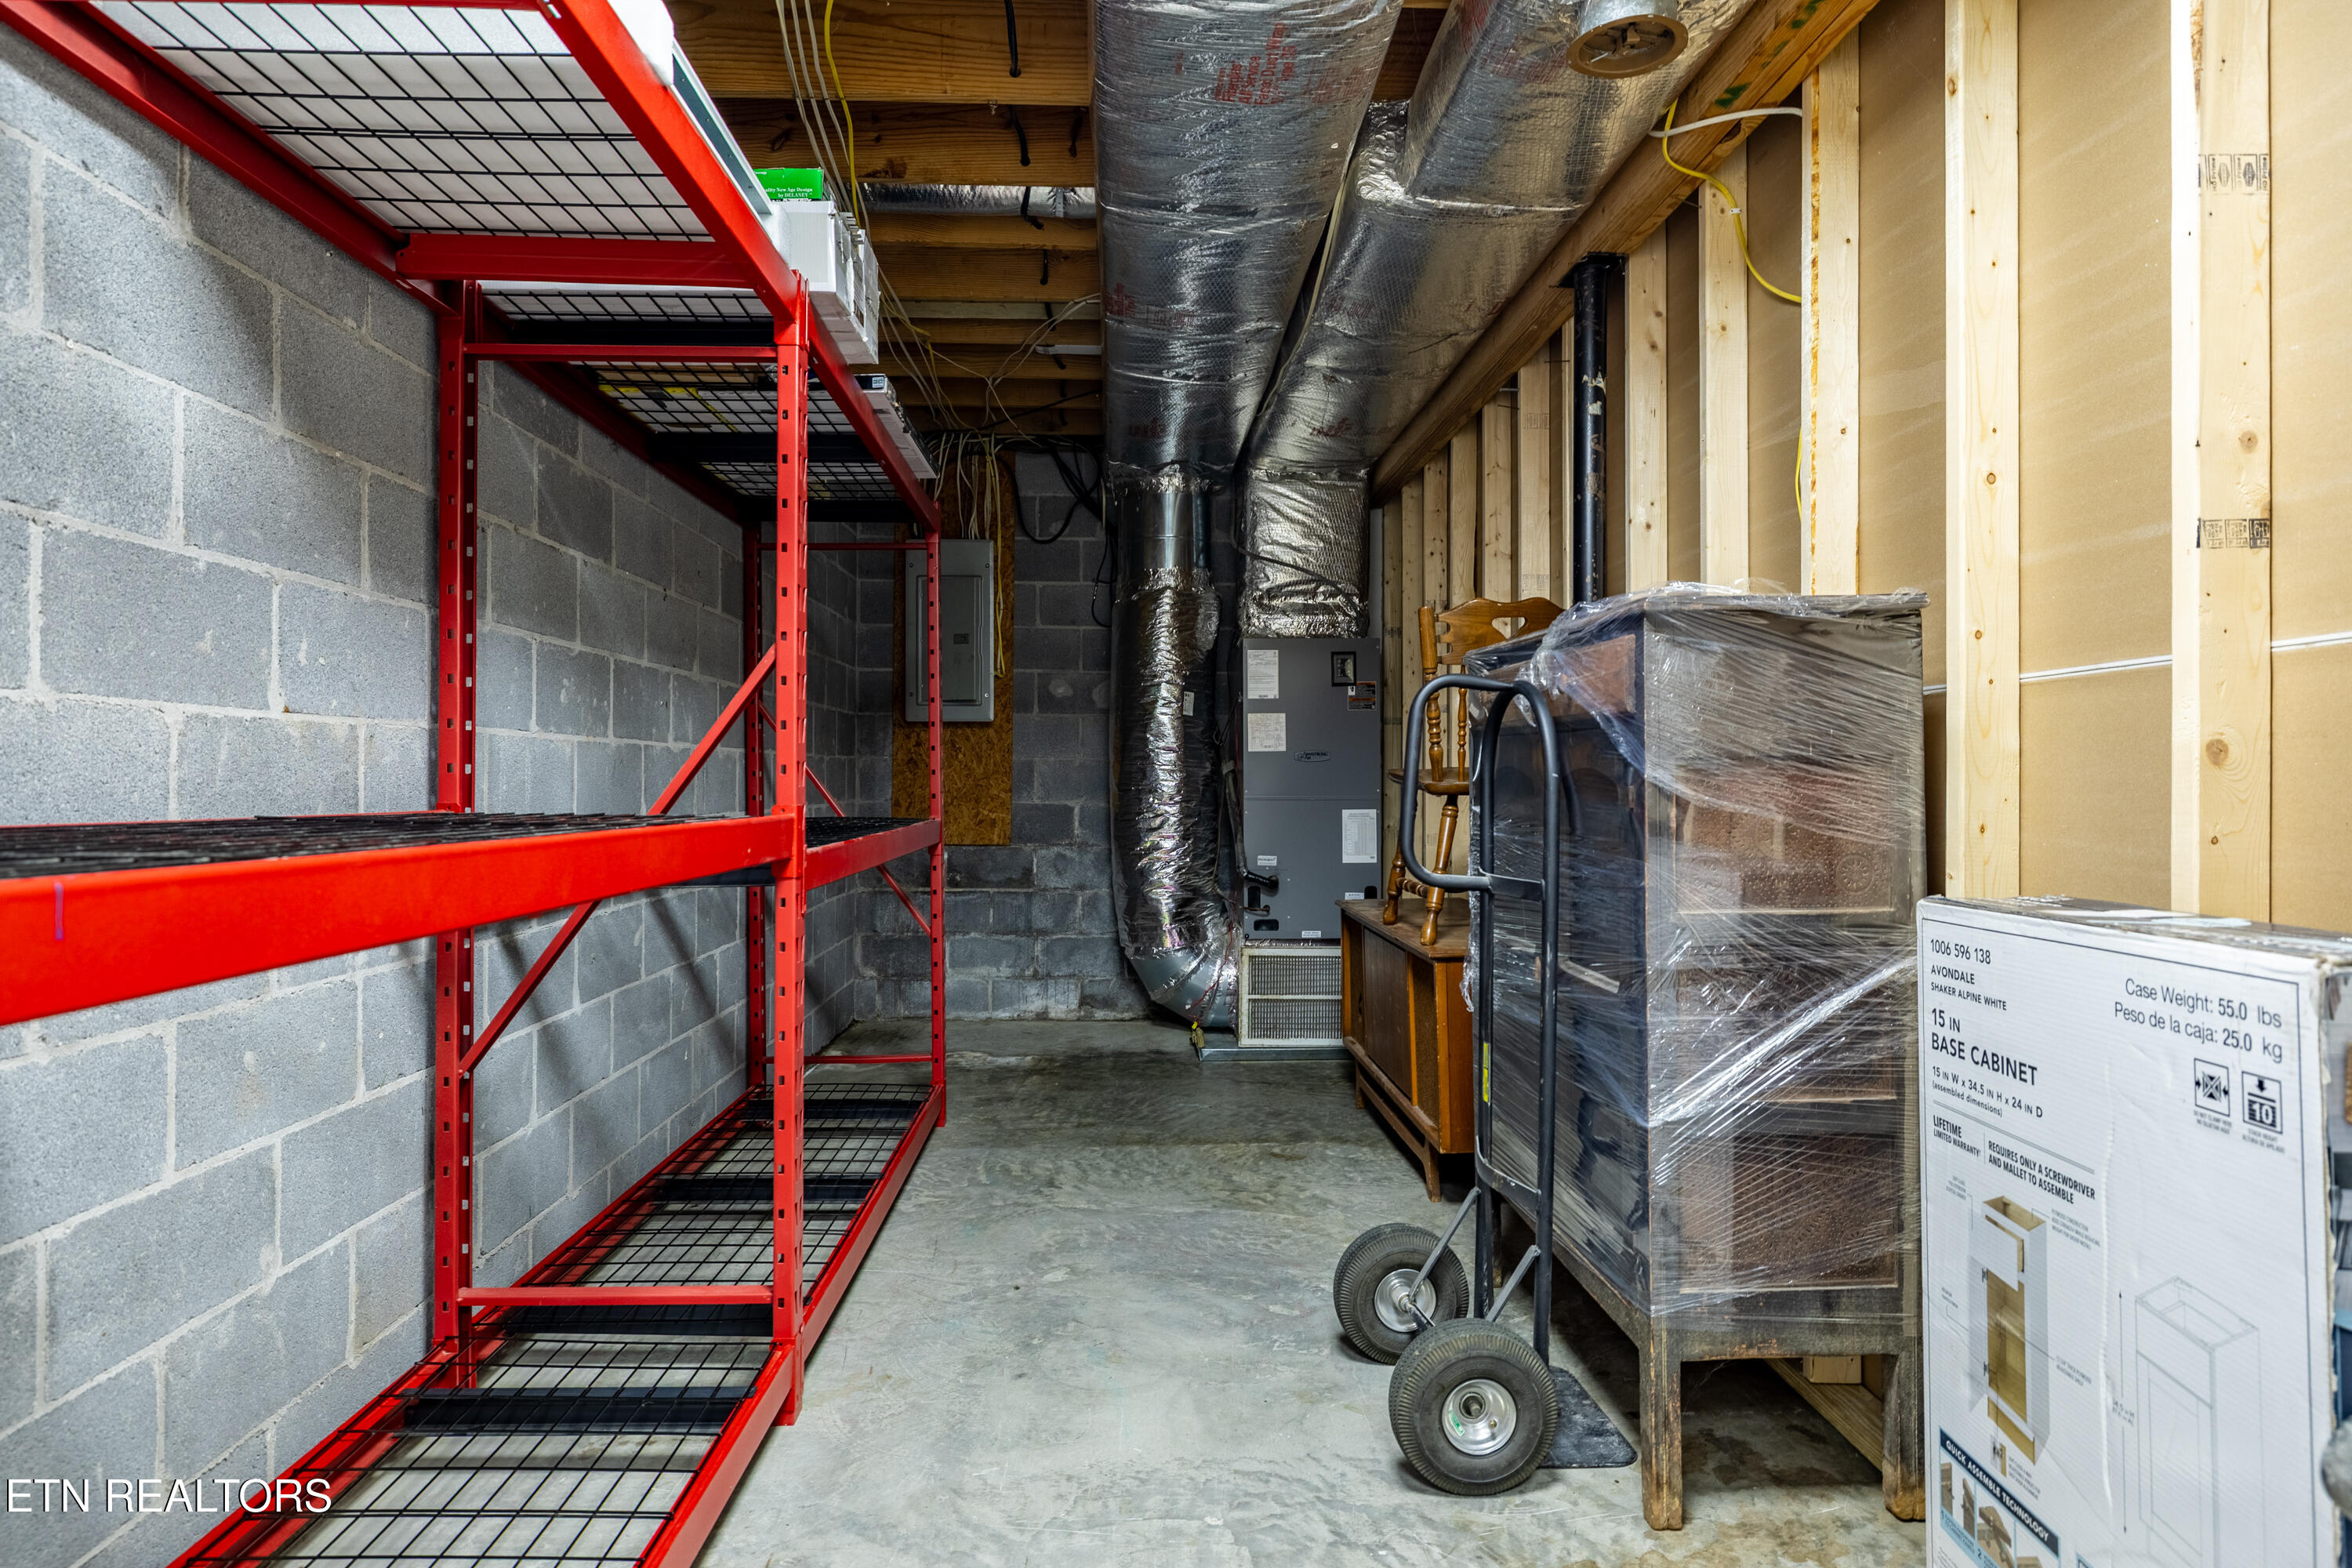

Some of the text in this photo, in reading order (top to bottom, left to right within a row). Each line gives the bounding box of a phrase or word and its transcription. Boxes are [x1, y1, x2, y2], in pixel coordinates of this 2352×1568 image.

[1931, 939, 1991, 964] 1006 596 138
[1931, 964, 1975, 984] AVONDALE
[1931, 982, 2007, 1011] SHAKER ALPINE WHITE
[2126, 978, 2282, 1028] Case Weight: 55.0 lbs
[1932, 1008, 1960, 1033] 15 IN
[2115, 1001, 2283, 1064] Peso de la caja: 25.0 kg
[1932, 1032, 2037, 1086] BASE CABINET
[1932, 1080, 2002, 1117] (assembled dimensions)
[1933, 1066, 1940, 1077] 15
[1943, 1071, 1949, 1081] IN
[1951, 1073, 1959, 1084] W
[1968, 1080, 1984, 1095] 34.5
[1987, 1089, 1994, 1099] IN
[1996, 1092, 2002, 1102] H
[2012, 1097, 2022, 1110] 24
[2025, 1104, 2033, 1114] IN
[2036, 1106, 2043, 1118] D
[1933, 1114, 1962, 1138] LIFETIME
[2252, 1102, 2272, 1124] 10
[1934, 1128, 1952, 1144] LIMITED
[1988, 1140, 2096, 1200] REQUIRES ONLY A SCREWDRIVER
[1989, 1154, 2074, 1204] AND MALLET TO ASSEMBLE
[1946, 1440, 1966, 1465] QUICK
[1968, 1461, 2001, 1498] ASSEMBLE
[2002, 1492, 2049, 1541] TECHNOLOGY
